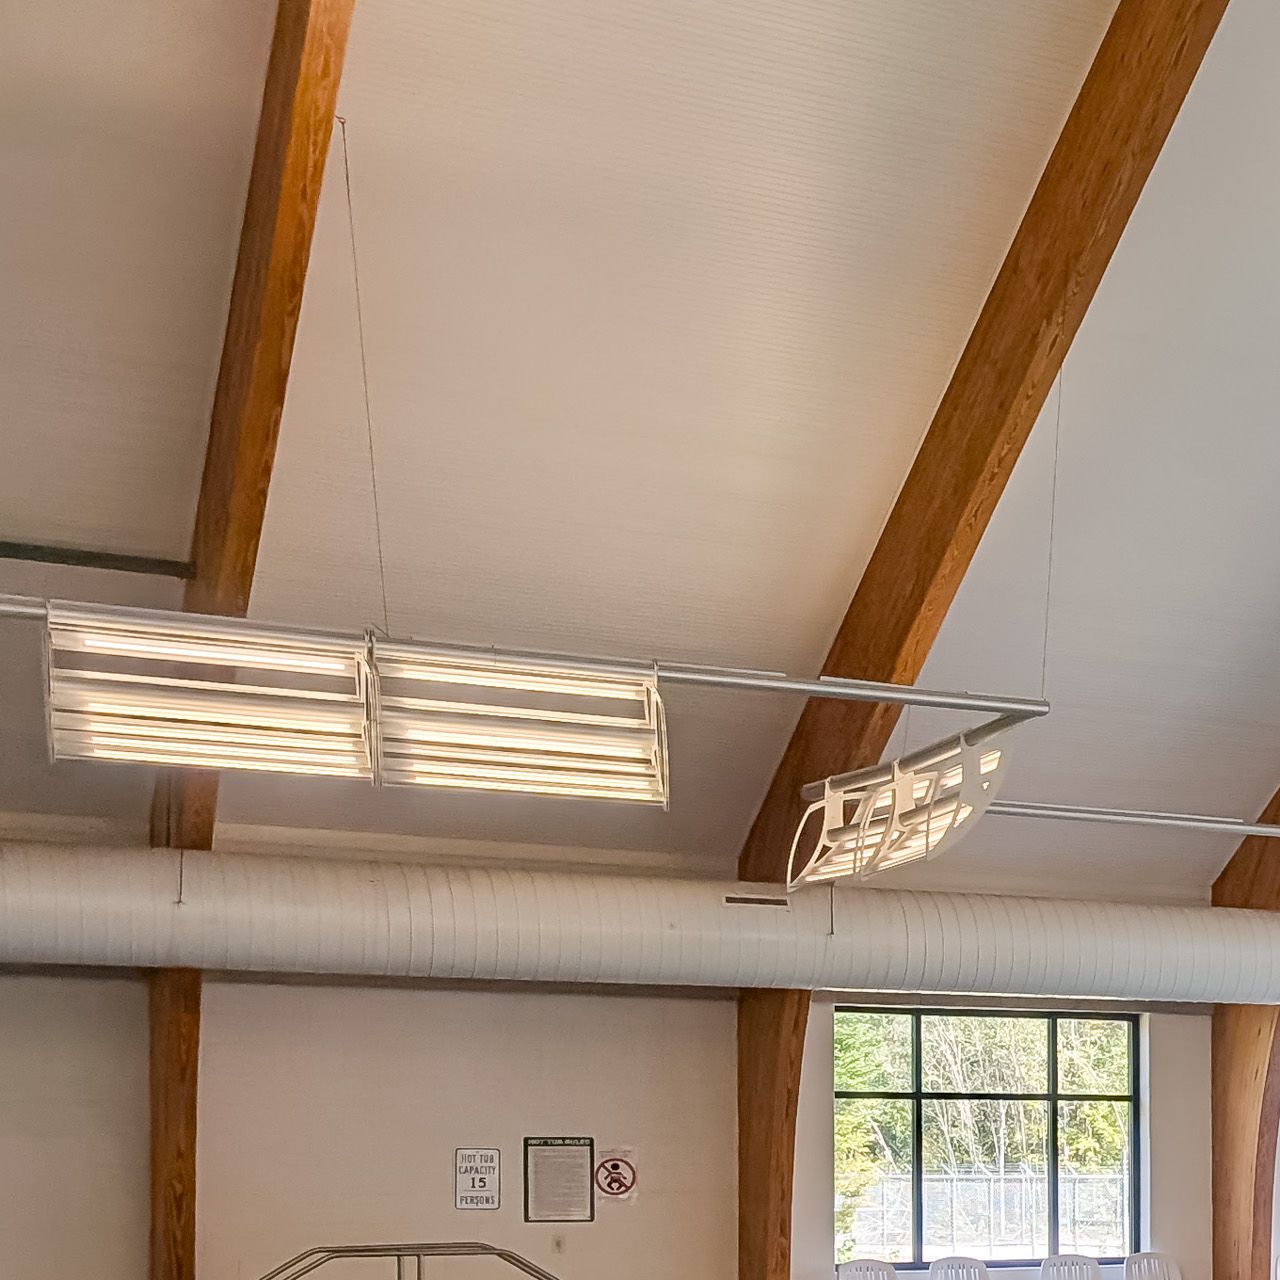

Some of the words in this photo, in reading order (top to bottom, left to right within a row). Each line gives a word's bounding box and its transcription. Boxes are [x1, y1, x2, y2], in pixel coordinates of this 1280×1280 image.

[461, 1154, 476, 1164] HOT
[480, 1154, 494, 1164] TUB
[458, 1165, 497, 1175] CAPACITY
[471, 1177, 487, 1189] 15
[459, 1195, 496, 1205] PERSONS
